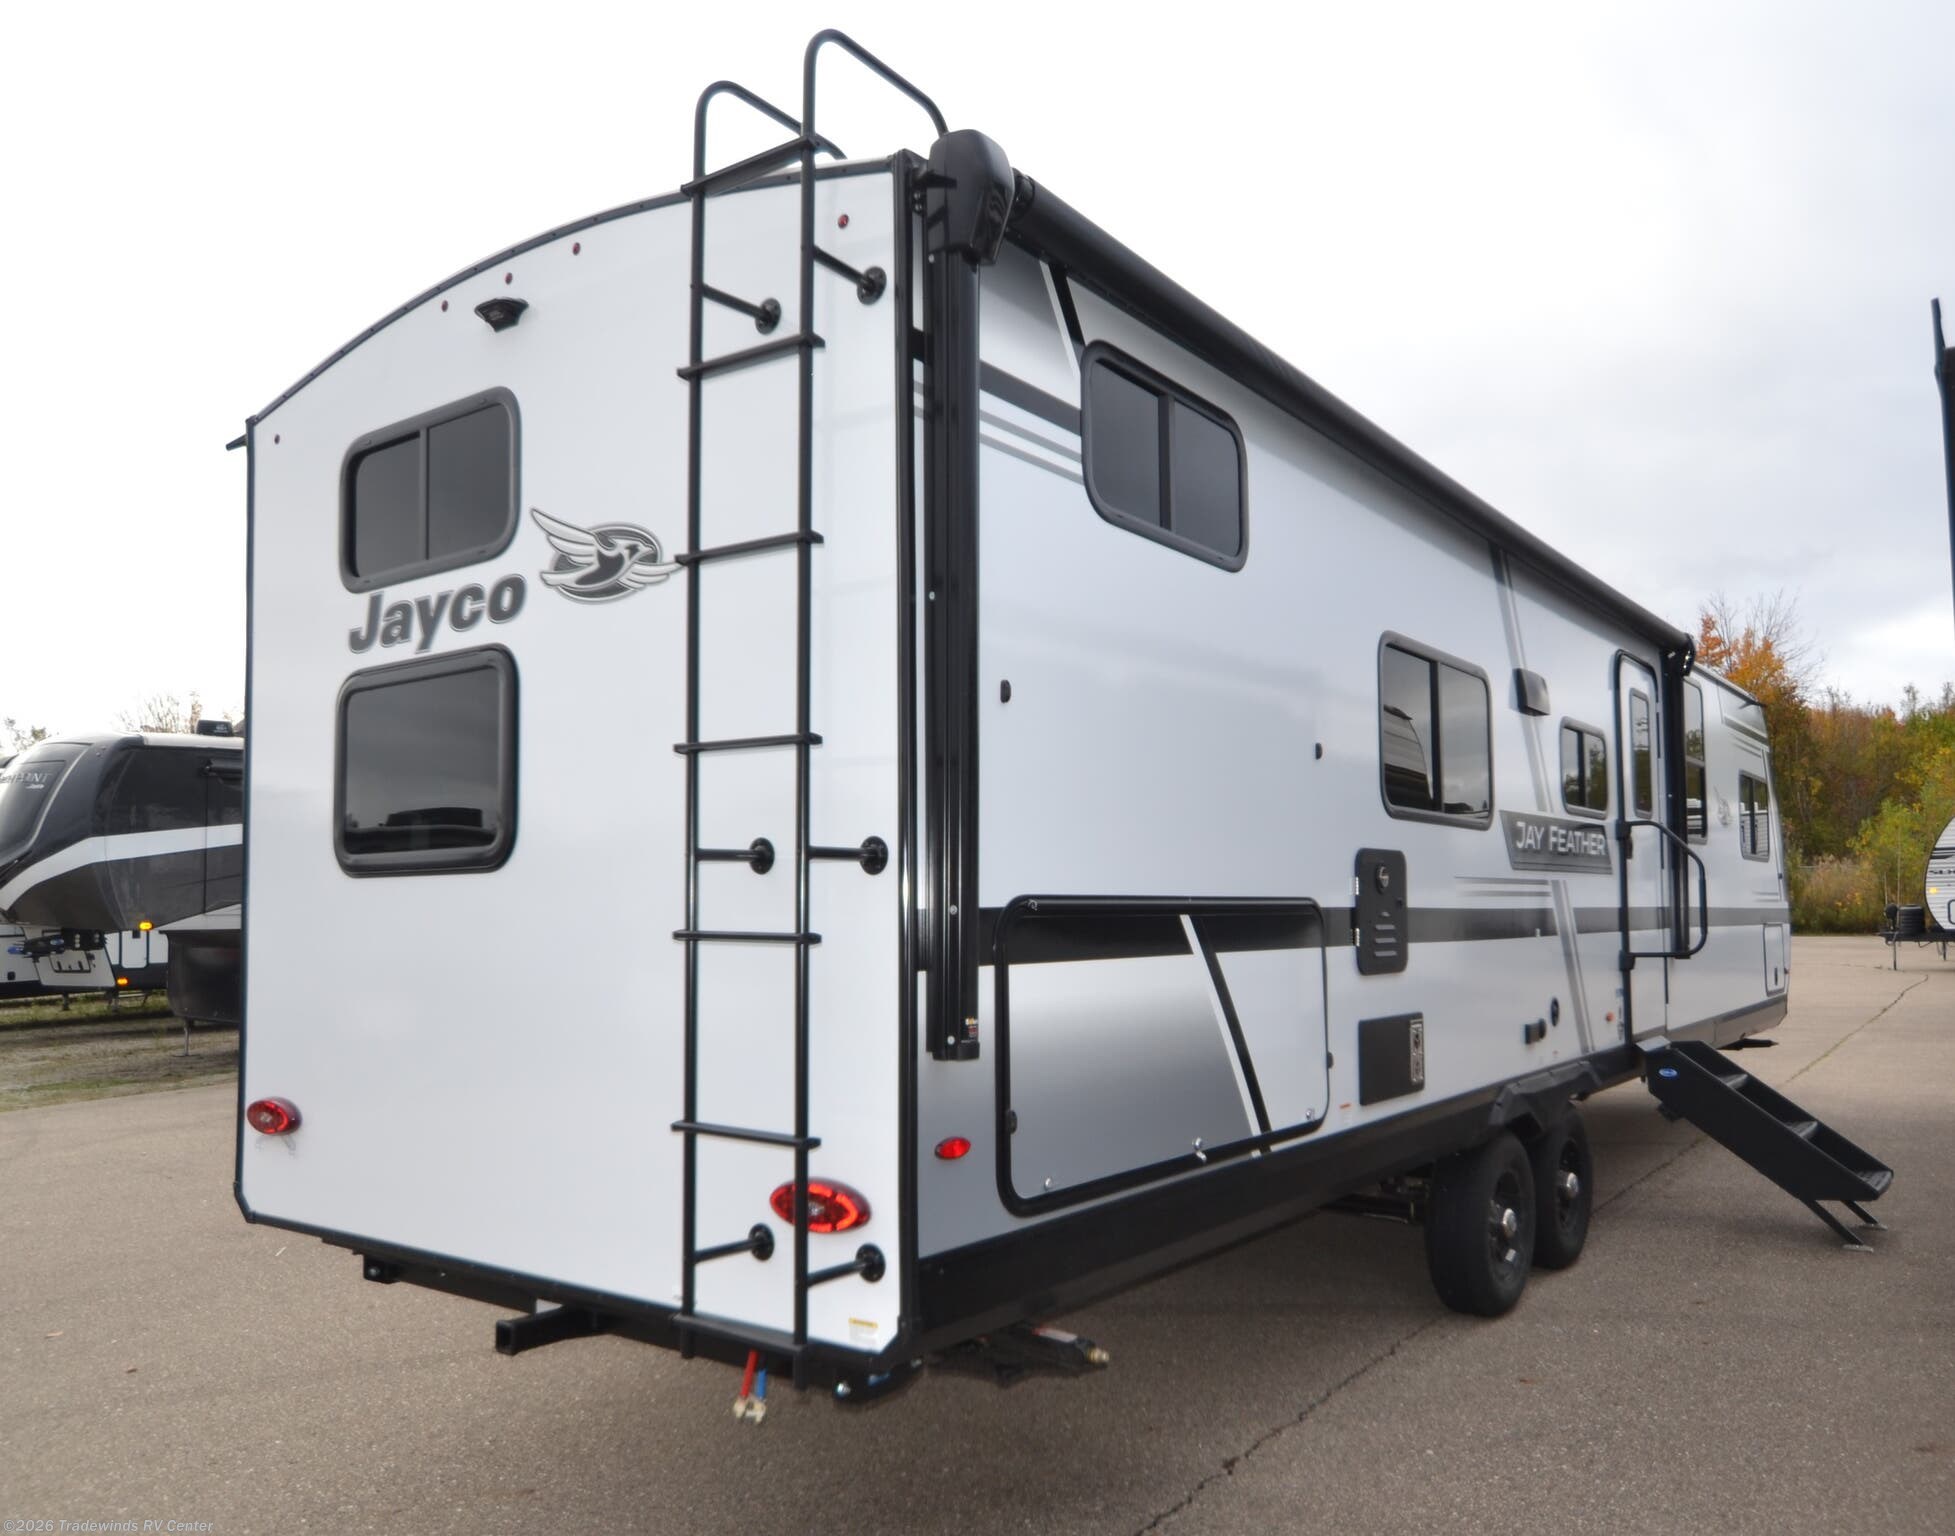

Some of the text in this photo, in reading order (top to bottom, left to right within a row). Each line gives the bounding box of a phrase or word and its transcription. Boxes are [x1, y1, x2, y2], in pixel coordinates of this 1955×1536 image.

[348, 572, 528, 654] Jayco
[1515, 820, 1607, 856] JAY FEATHER
